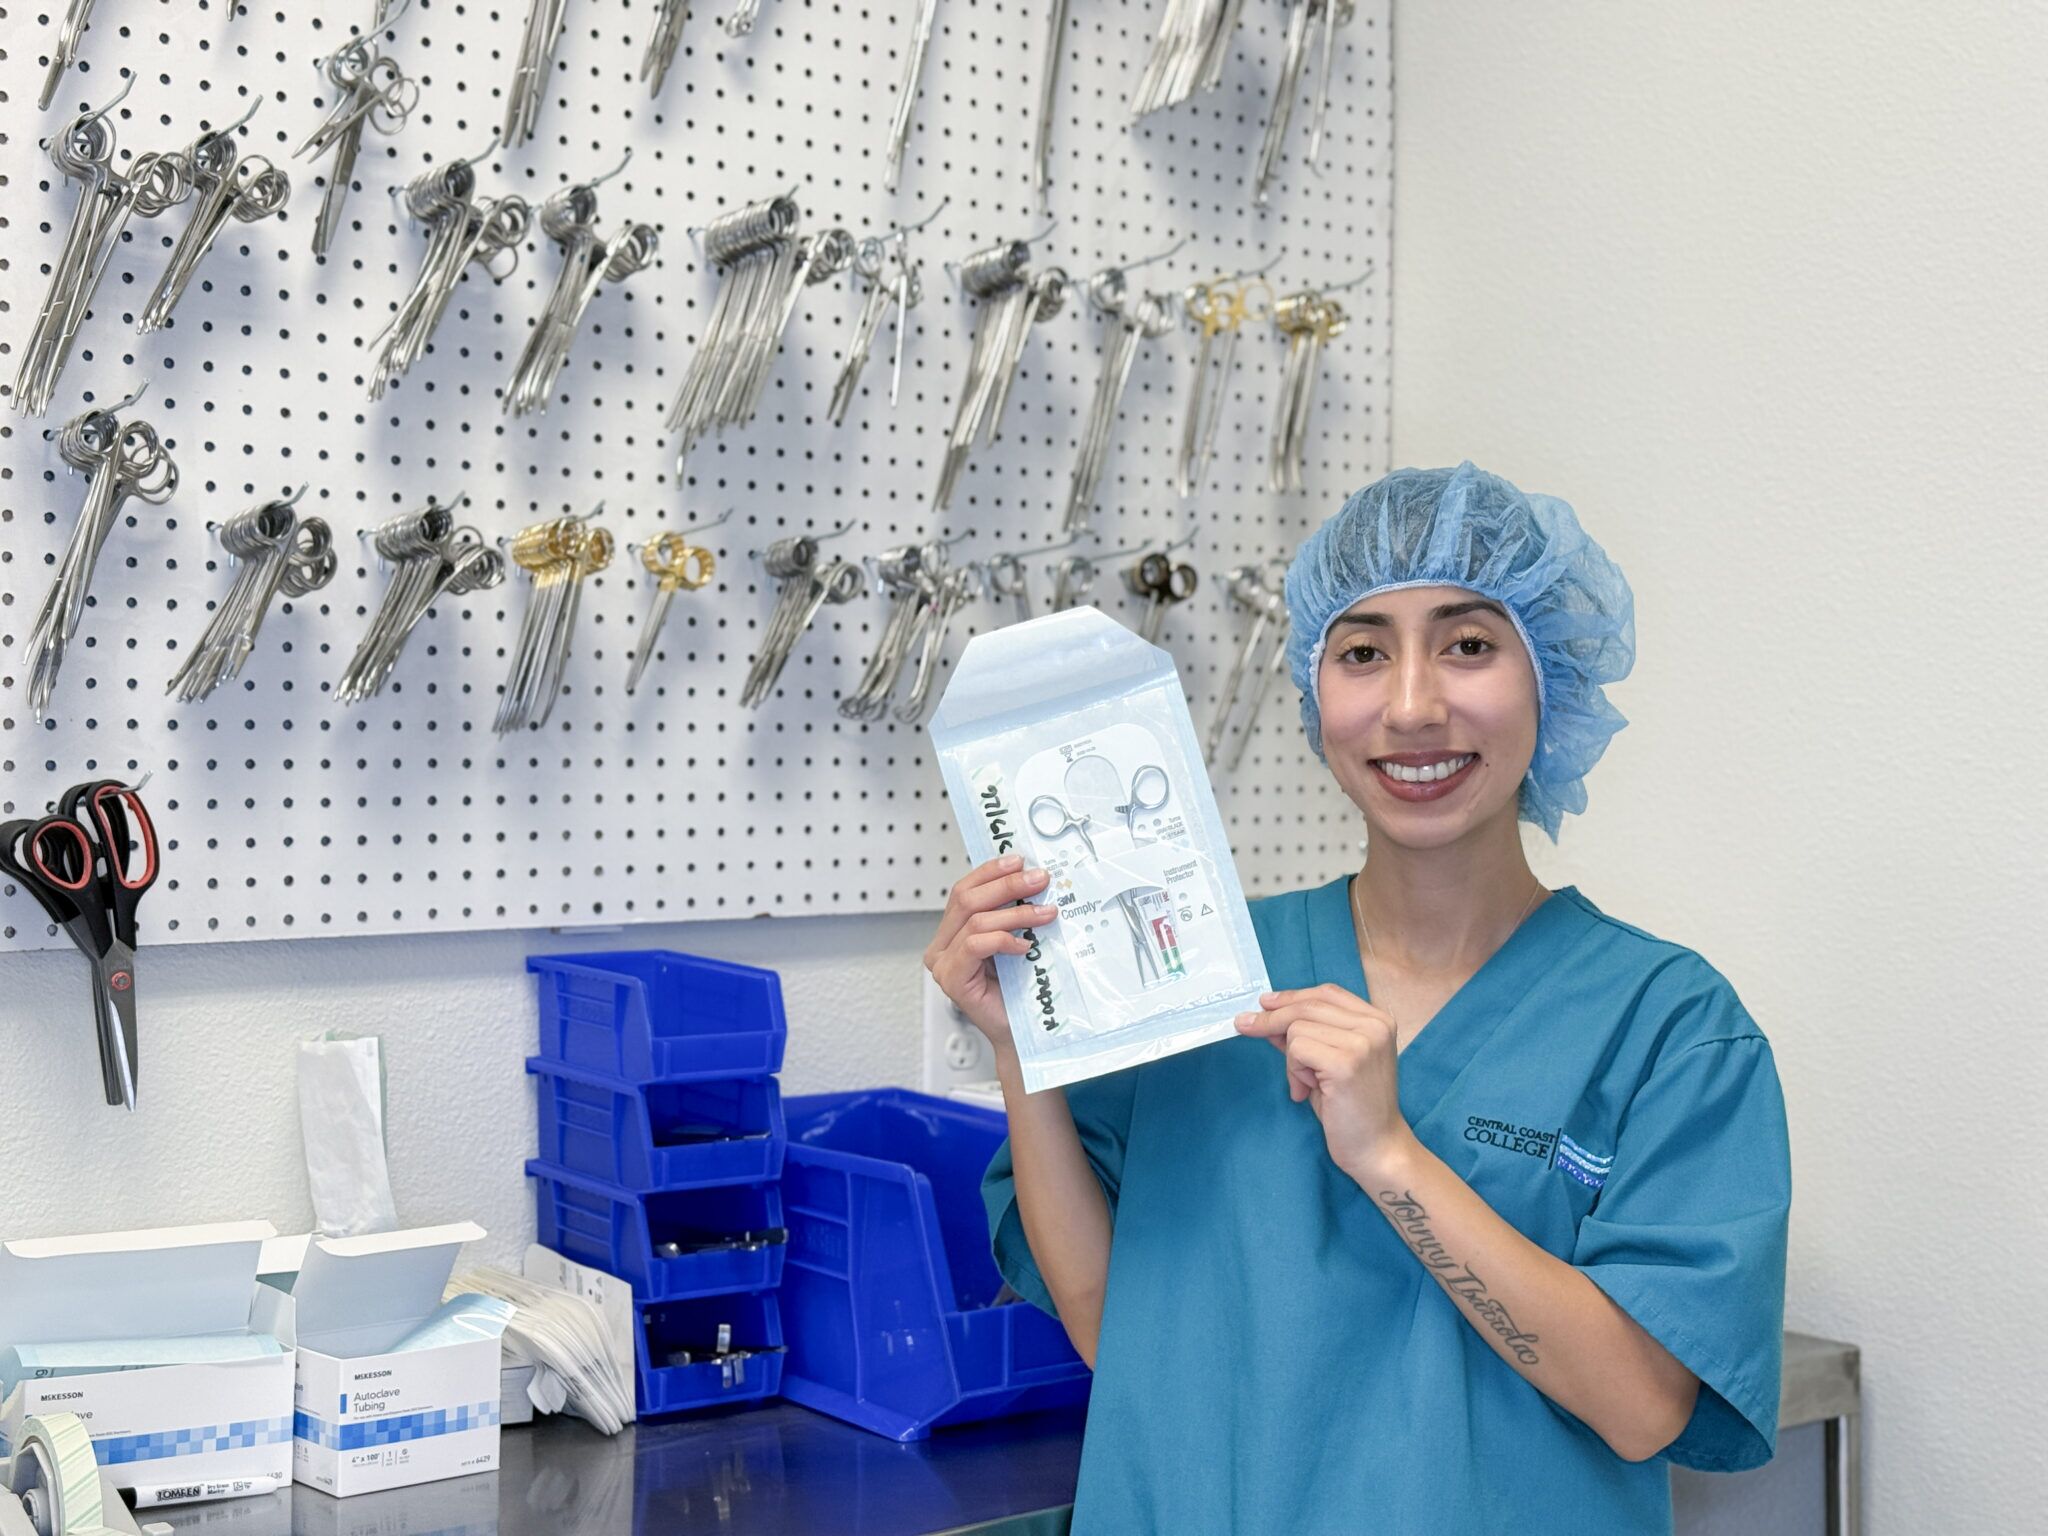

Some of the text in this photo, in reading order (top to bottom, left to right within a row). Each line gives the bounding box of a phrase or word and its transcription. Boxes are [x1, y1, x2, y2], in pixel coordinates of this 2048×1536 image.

[1163, 859, 1198, 877] Instrument
[1165, 869, 1196, 885] Protector
[1057, 893, 1076, 907] 3M
[1467, 1115, 1556, 1144] CENTRAL COAST
[1463, 1126, 1550, 1160] COLLEGE
[1379, 1189, 1459, 1272] Johnny
[353, 1387, 401, 1402] Autoclave
[353, 1401, 386, 1414] Tubing
